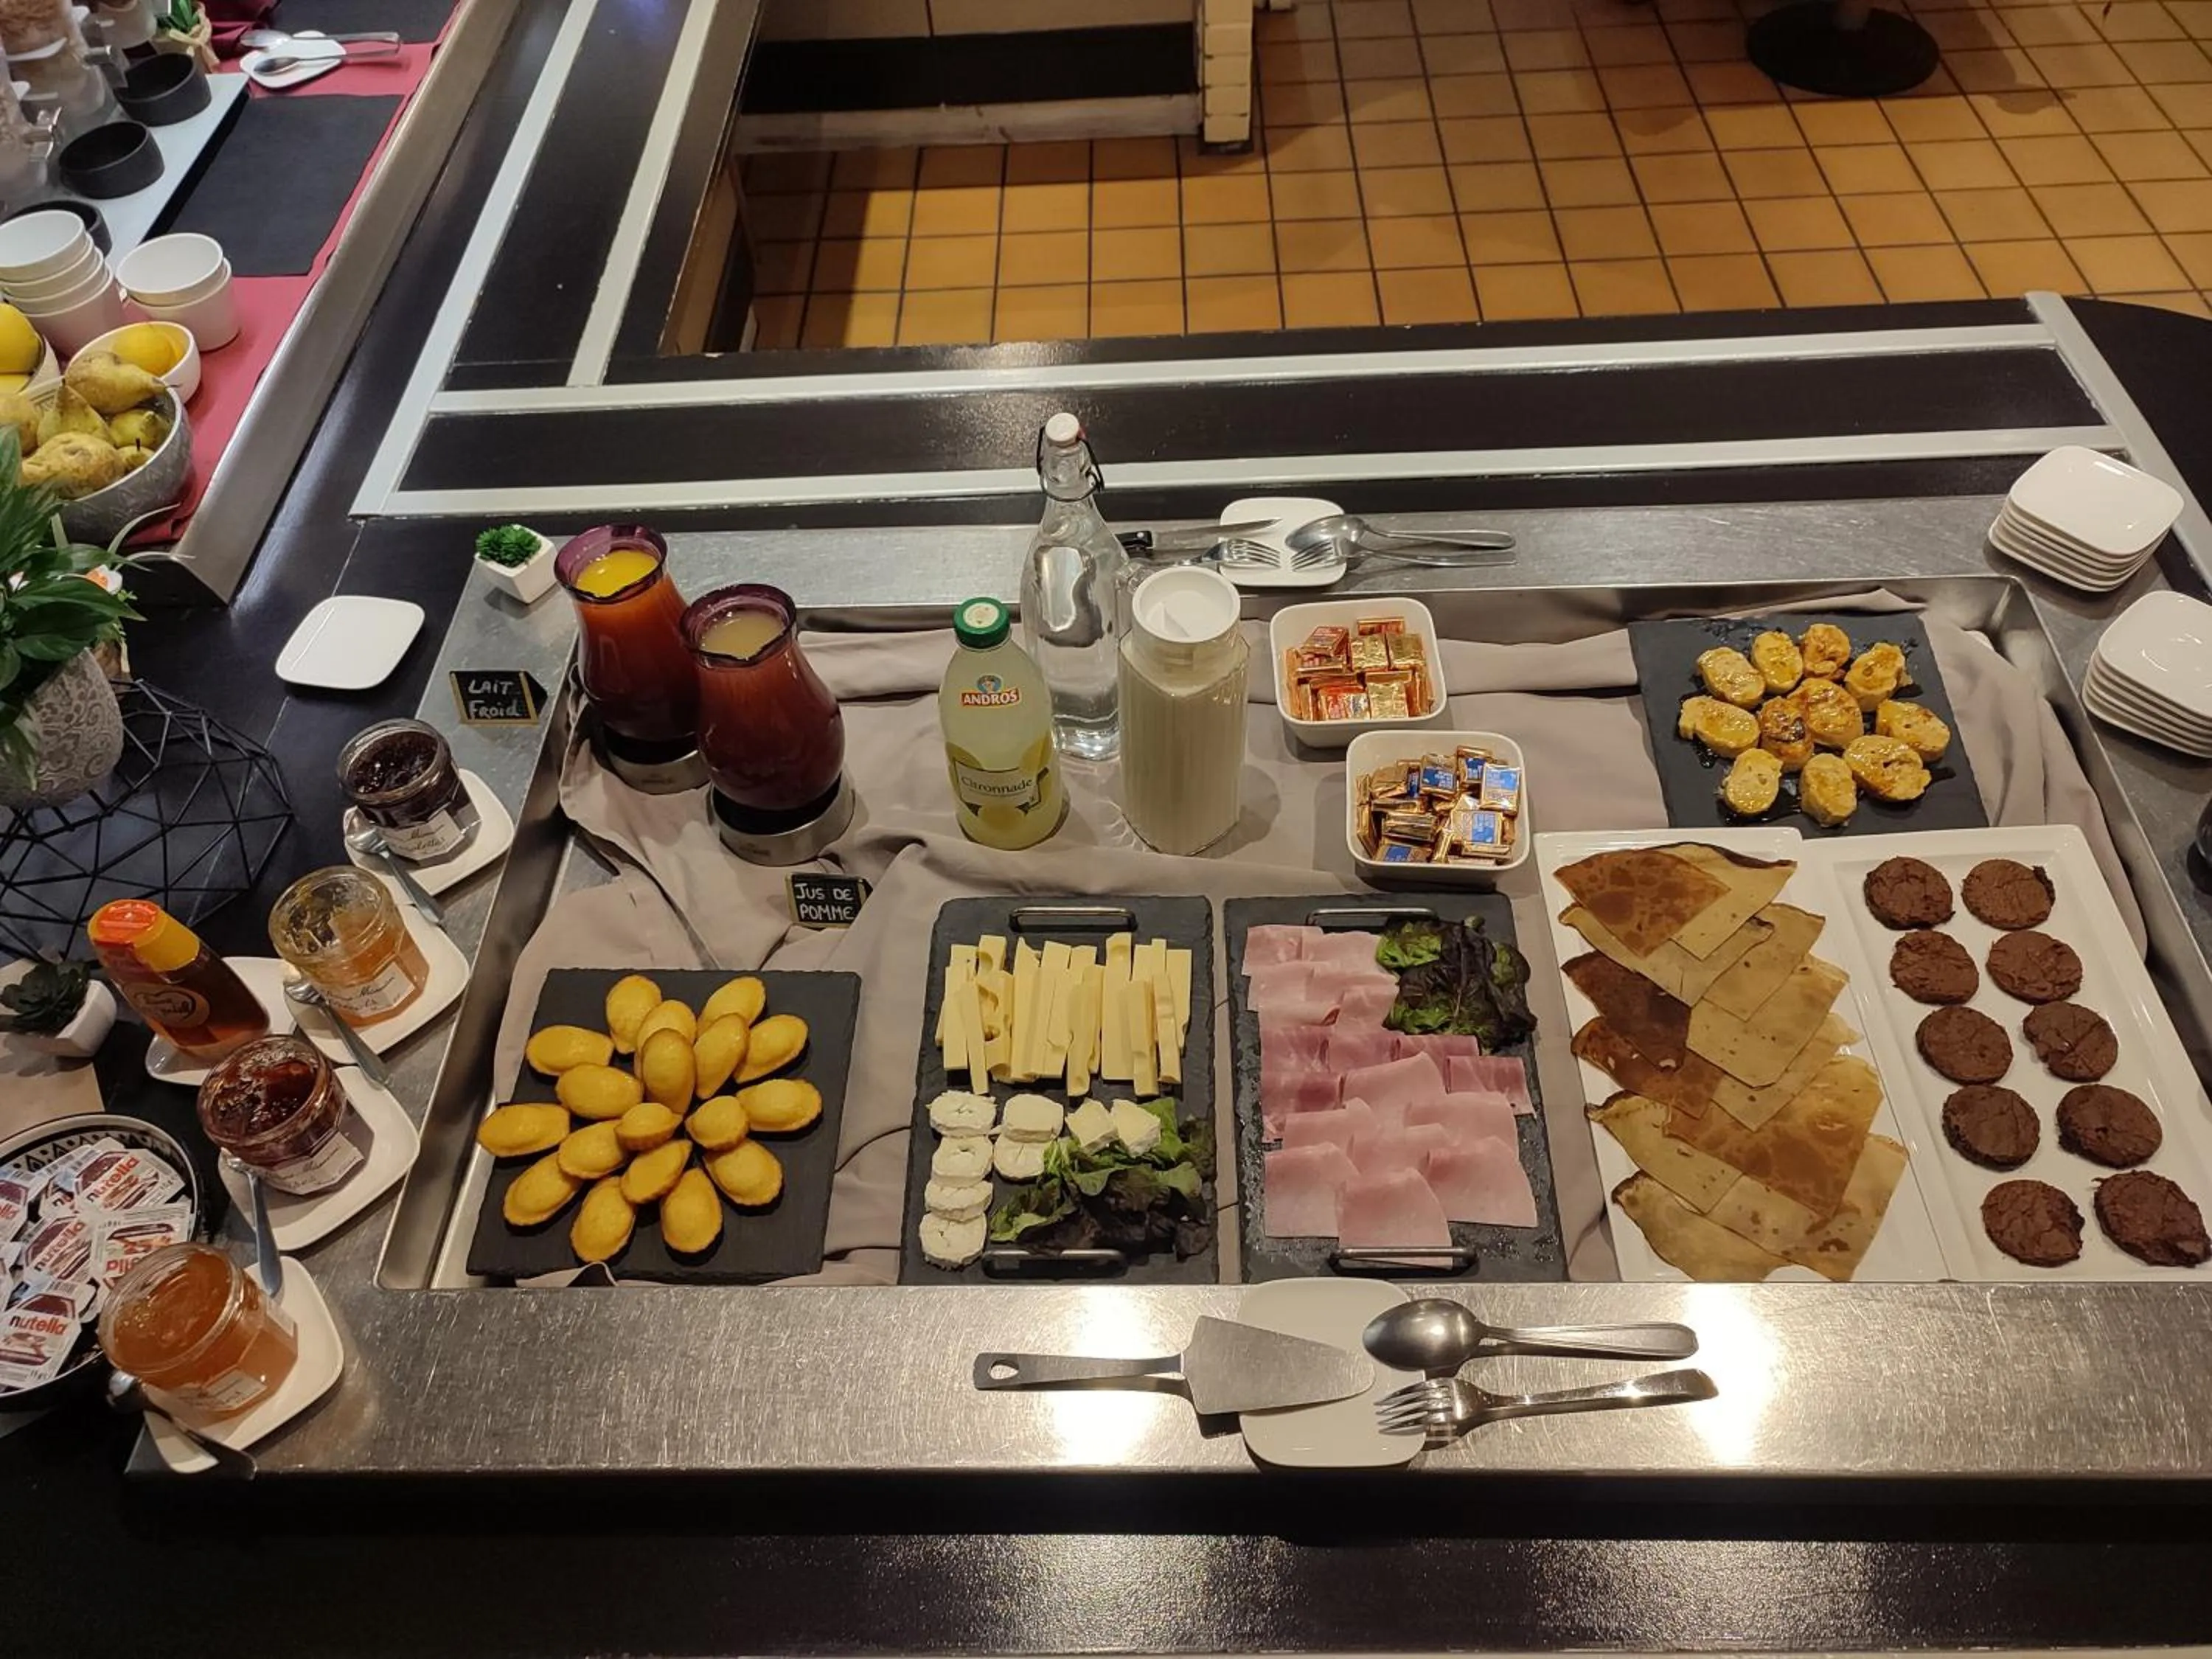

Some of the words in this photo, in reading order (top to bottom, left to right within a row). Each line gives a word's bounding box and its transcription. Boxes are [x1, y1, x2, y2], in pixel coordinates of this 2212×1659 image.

[963, 690, 1018, 706] ANDROS
[961, 776, 1033, 794] Citronnade
[832, 888, 854, 901] DE
[799, 904, 855, 921] POMME
[86, 1155, 141, 1203] nutella
[34, 1220, 86, 1272] nutella
[9, 1315, 68, 1336] nutella
